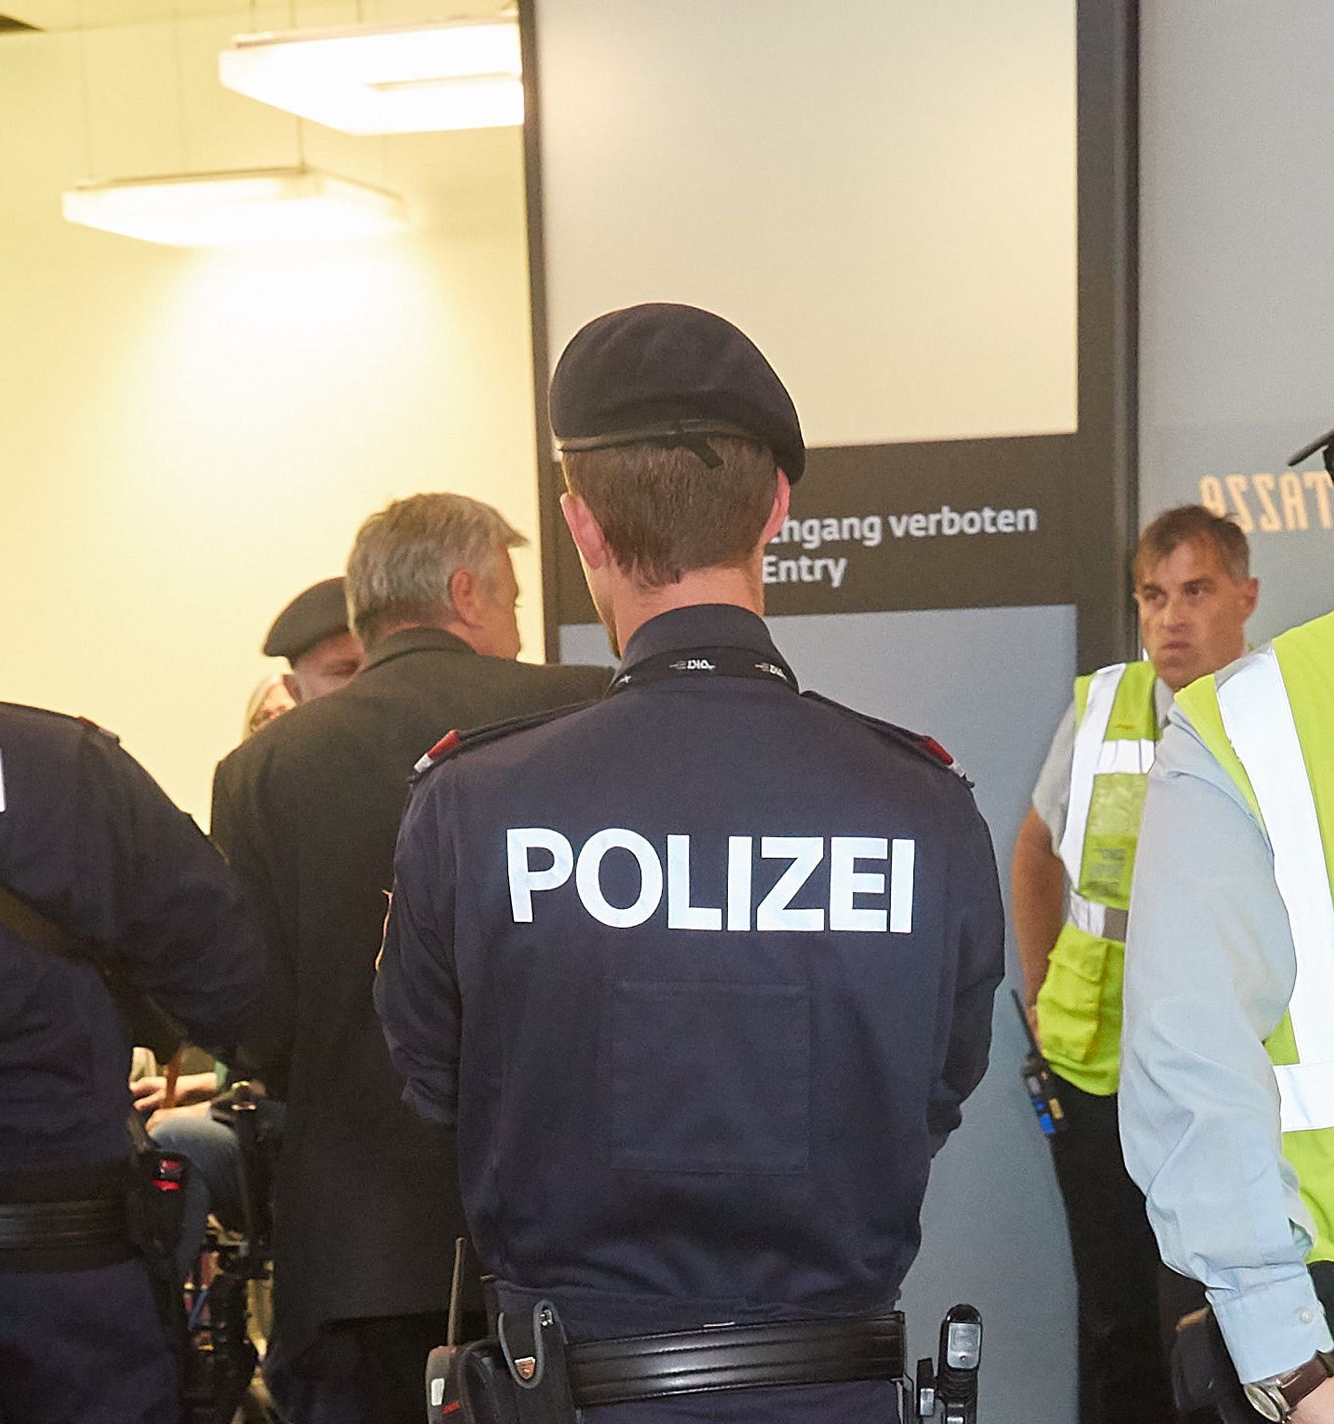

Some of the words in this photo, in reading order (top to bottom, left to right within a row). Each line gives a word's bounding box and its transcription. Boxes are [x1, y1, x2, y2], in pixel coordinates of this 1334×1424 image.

[770, 514, 882, 550] hgang
[888, 505, 1038, 538] verboten
[762, 555, 847, 588] Entry
[506, 827, 915, 933] POLIZEI
